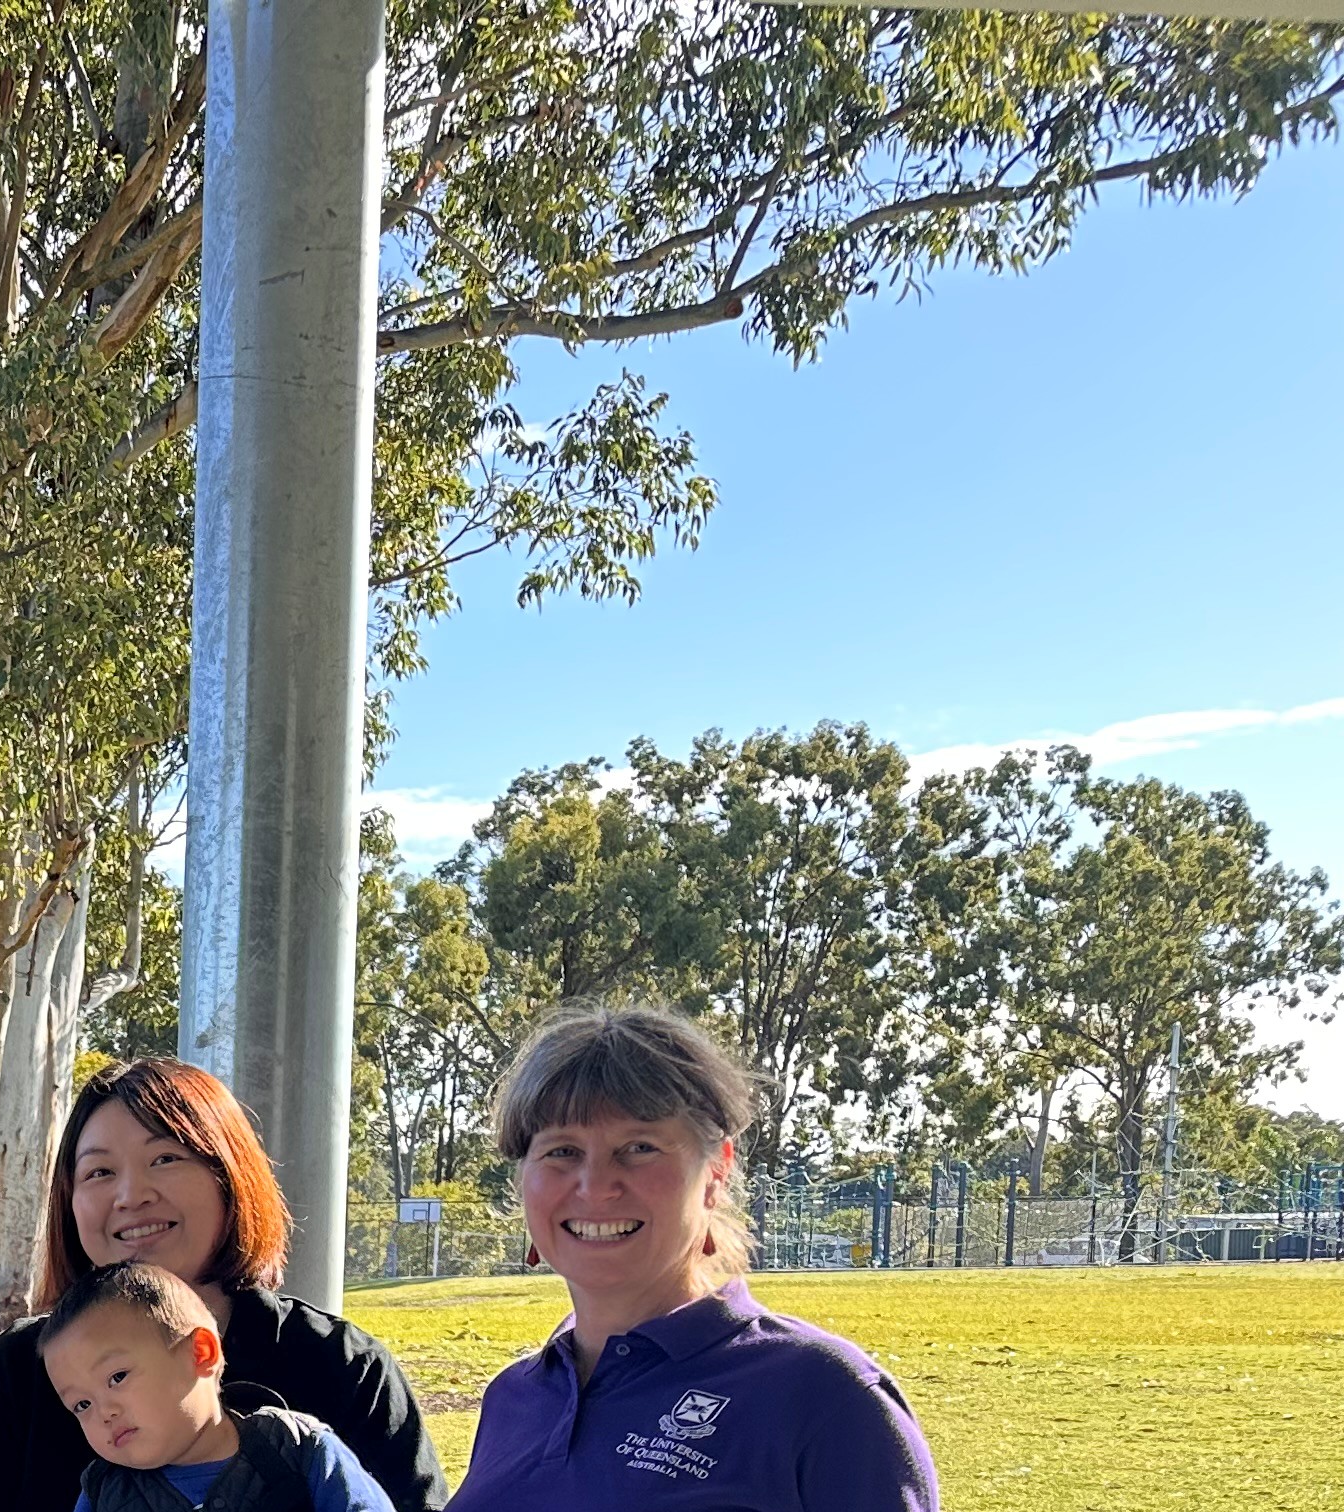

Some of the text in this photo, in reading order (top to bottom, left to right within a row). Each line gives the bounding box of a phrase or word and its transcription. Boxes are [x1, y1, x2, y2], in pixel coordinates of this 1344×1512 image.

[616, 1444, 708, 1480] OF QUEENSLAND
[626, 1432, 718, 1469] THE UNIVERSITY
[627, 1460, 678, 1478] AUSTRALIA
